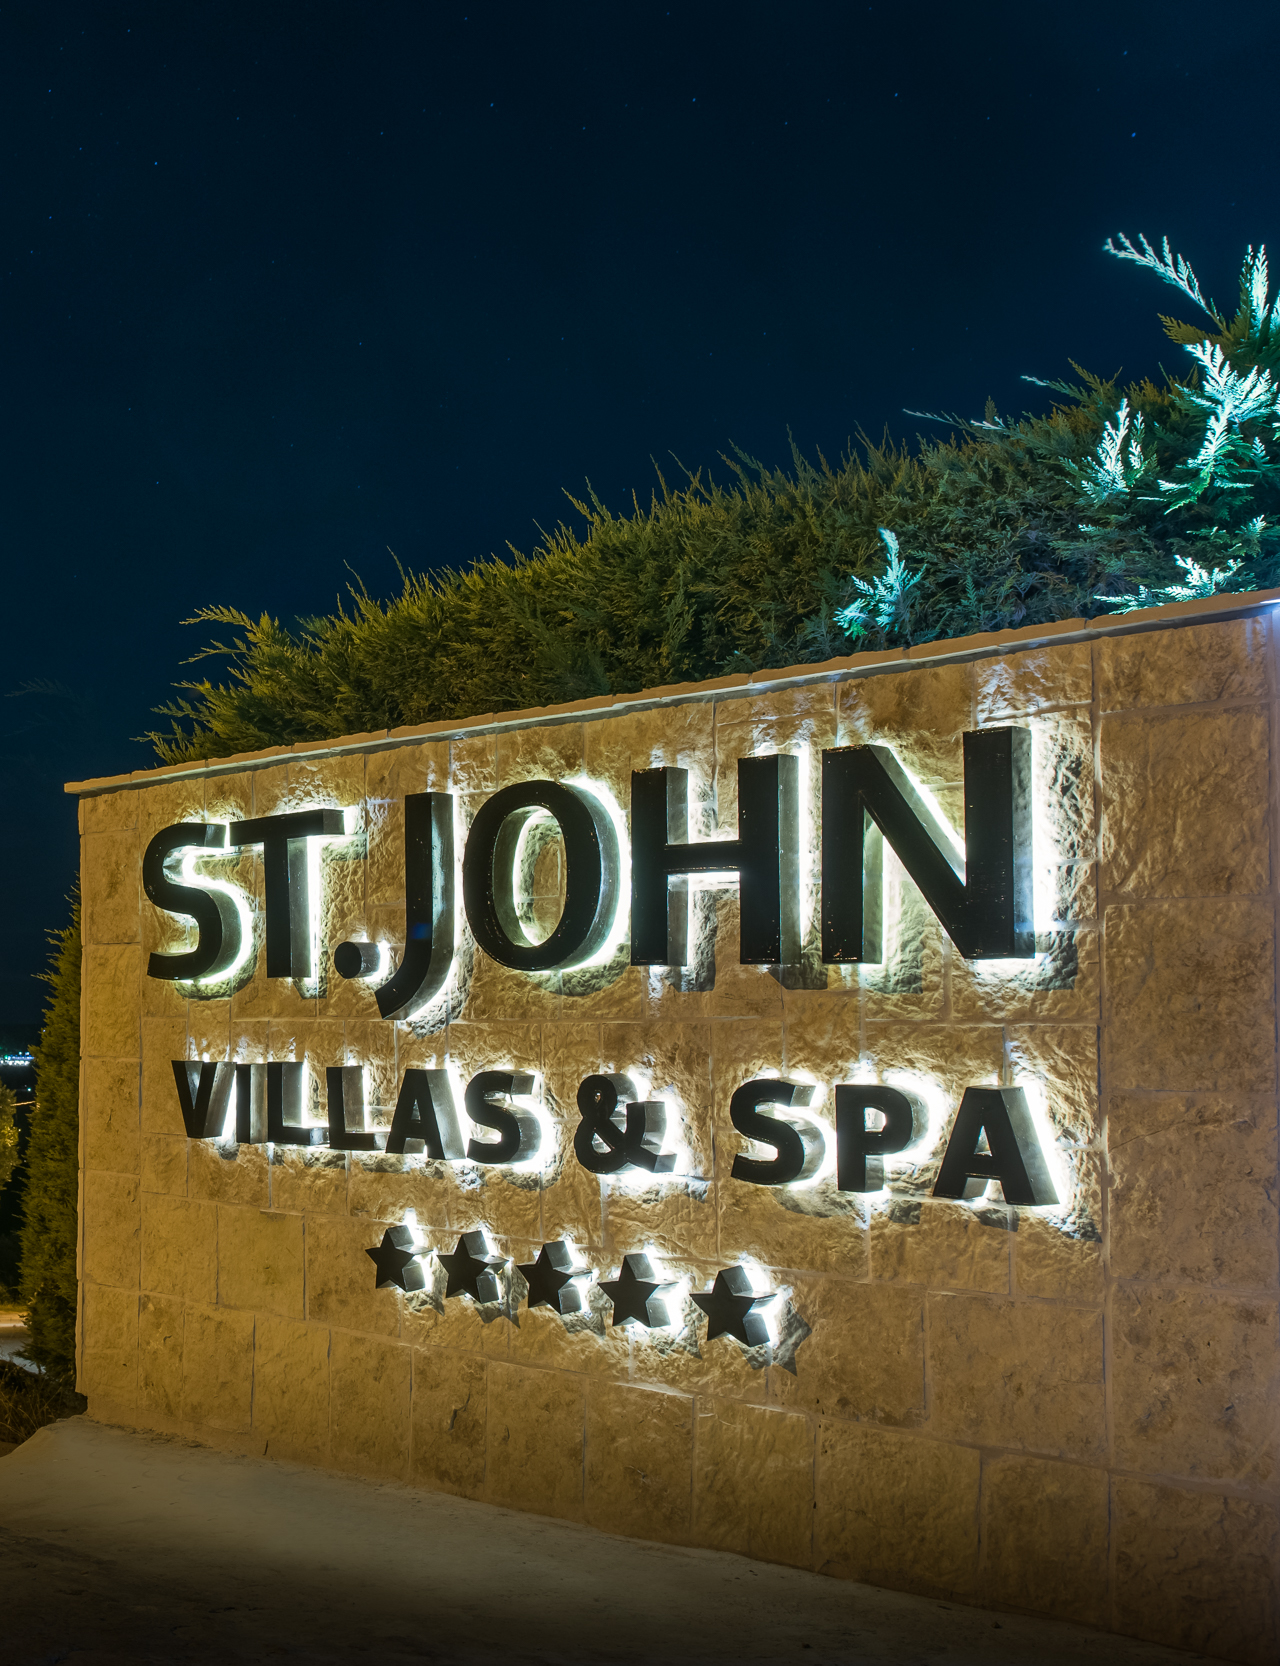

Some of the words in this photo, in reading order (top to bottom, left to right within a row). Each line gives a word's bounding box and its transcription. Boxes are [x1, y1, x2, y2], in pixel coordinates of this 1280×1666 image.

[171, 1059, 542, 1166] VILLAS
[574, 1073, 677, 1175] &
[730, 1077, 1059, 1206] SPA
